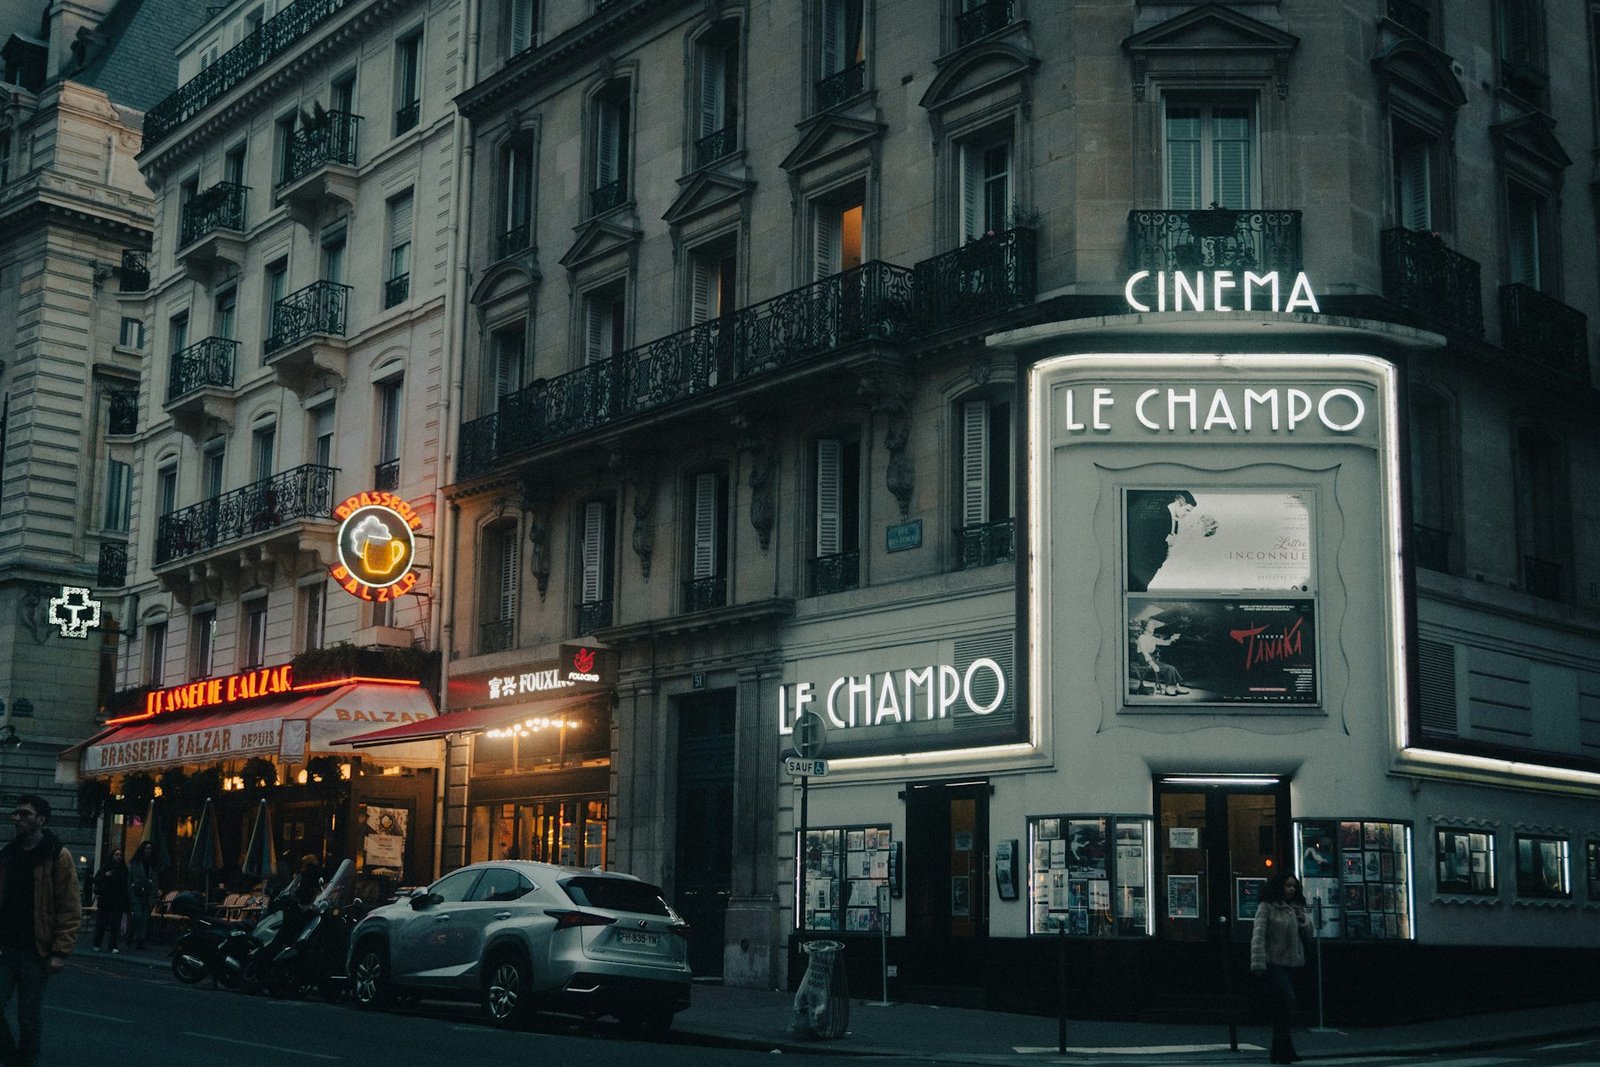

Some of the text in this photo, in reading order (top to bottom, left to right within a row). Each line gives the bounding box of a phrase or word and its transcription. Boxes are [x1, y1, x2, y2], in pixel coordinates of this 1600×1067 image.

[1125, 270, 1320, 313] CINEMA
[1066, 388, 1366, 432] LE CHAMPO
[335, 491, 422, 529] BRASSERIE
[1229, 551, 1307, 560] INCONNUE
[332, 565, 417, 602] BALZAR
[146, 665, 292, 715] BRASSERIE BALZAR
[519, 669, 576, 693] FOUXI
[779, 657, 1005, 736] LE CHAMPO
[101, 737, 169, 767] BRASSERIE
[177, 728, 231, 757] BALZAR
[241, 730, 274, 749] DEPUIS
[789, 761, 813, 772] SAUF
